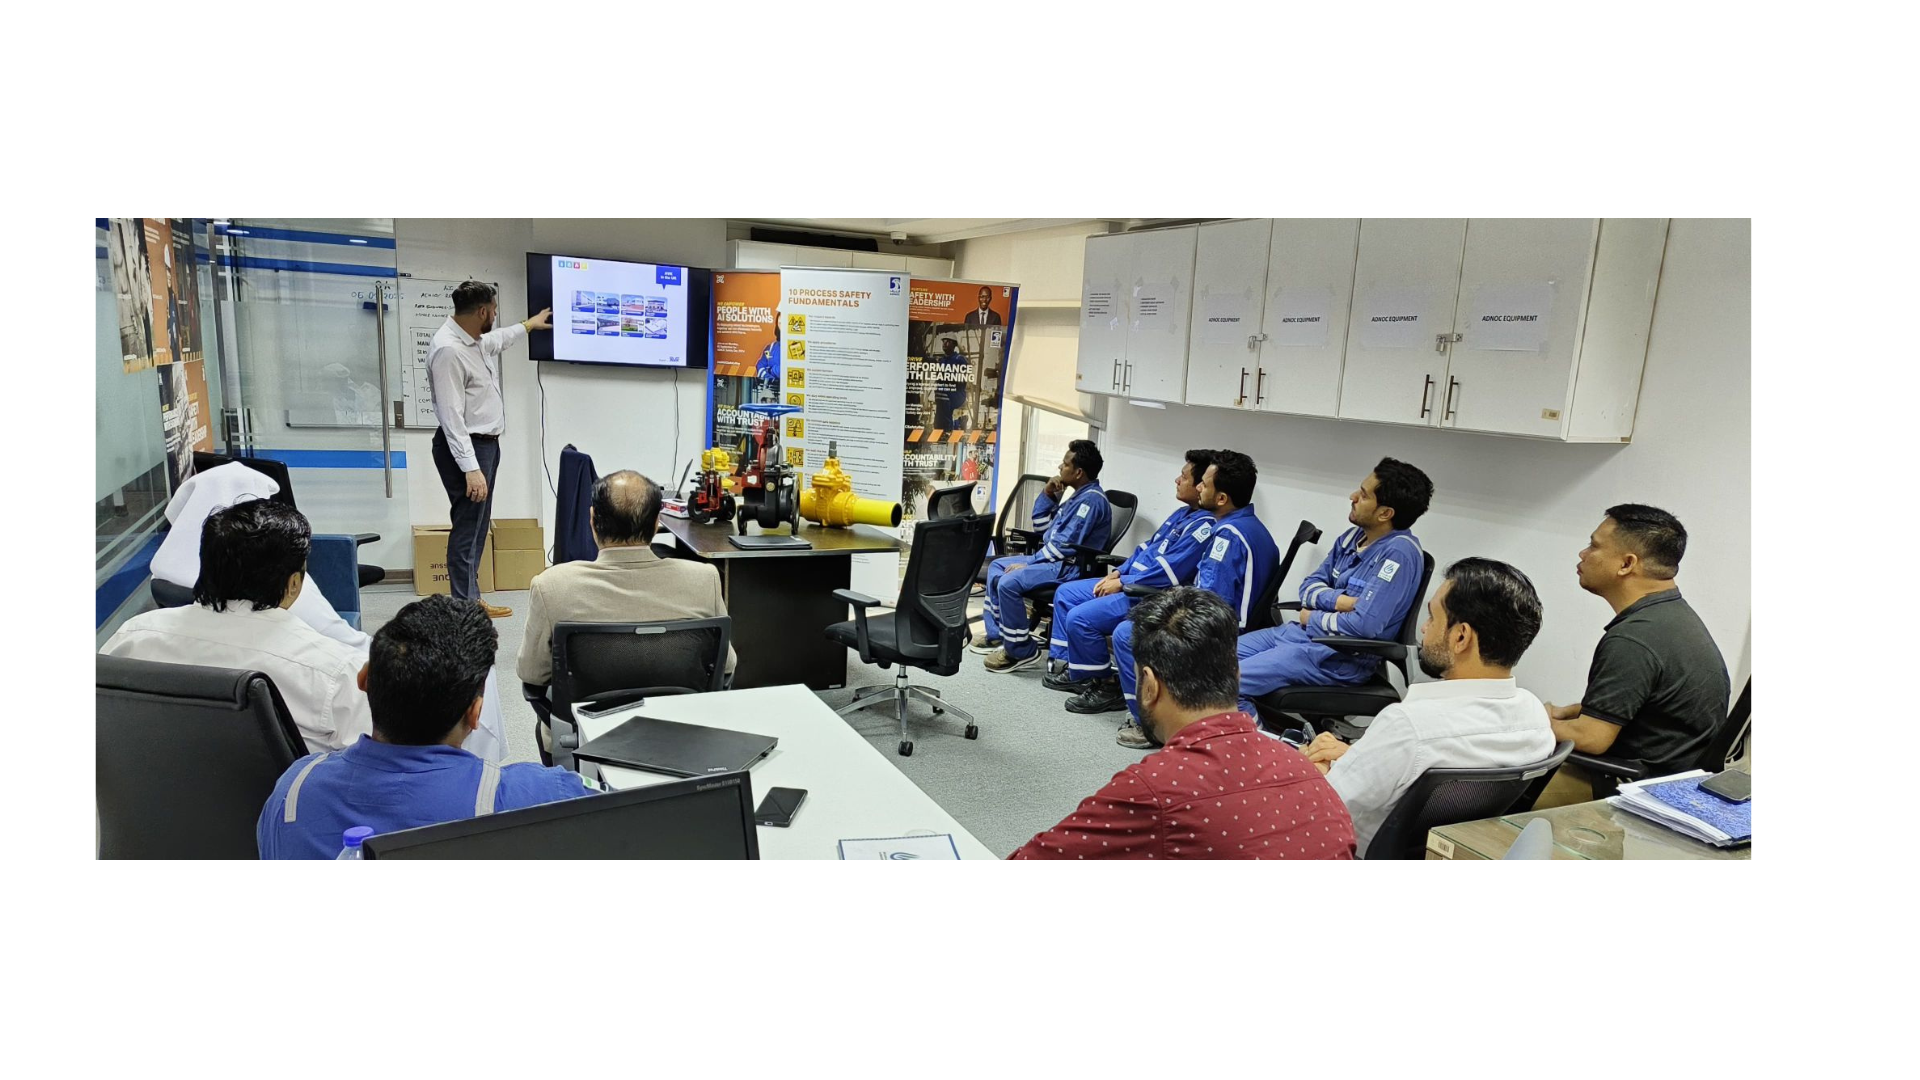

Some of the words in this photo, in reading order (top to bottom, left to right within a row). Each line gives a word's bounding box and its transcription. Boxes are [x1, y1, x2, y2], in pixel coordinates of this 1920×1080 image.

[800, 289, 837, 297] PROCESS
[839, 290, 871, 299] SAFETY
[789, 298, 859, 307] FUNDAMENTALS
[910, 299, 951, 307] EADERSHIP
[717, 306, 747, 314] PEOPLE
[726, 314, 773, 323] SOLUTIONS
[907, 362, 972, 373] ERFORMANCE
[925, 372, 974, 382] LEARNING
[717, 416, 735, 424] WITH
[737, 417, 764, 426] TRUST
